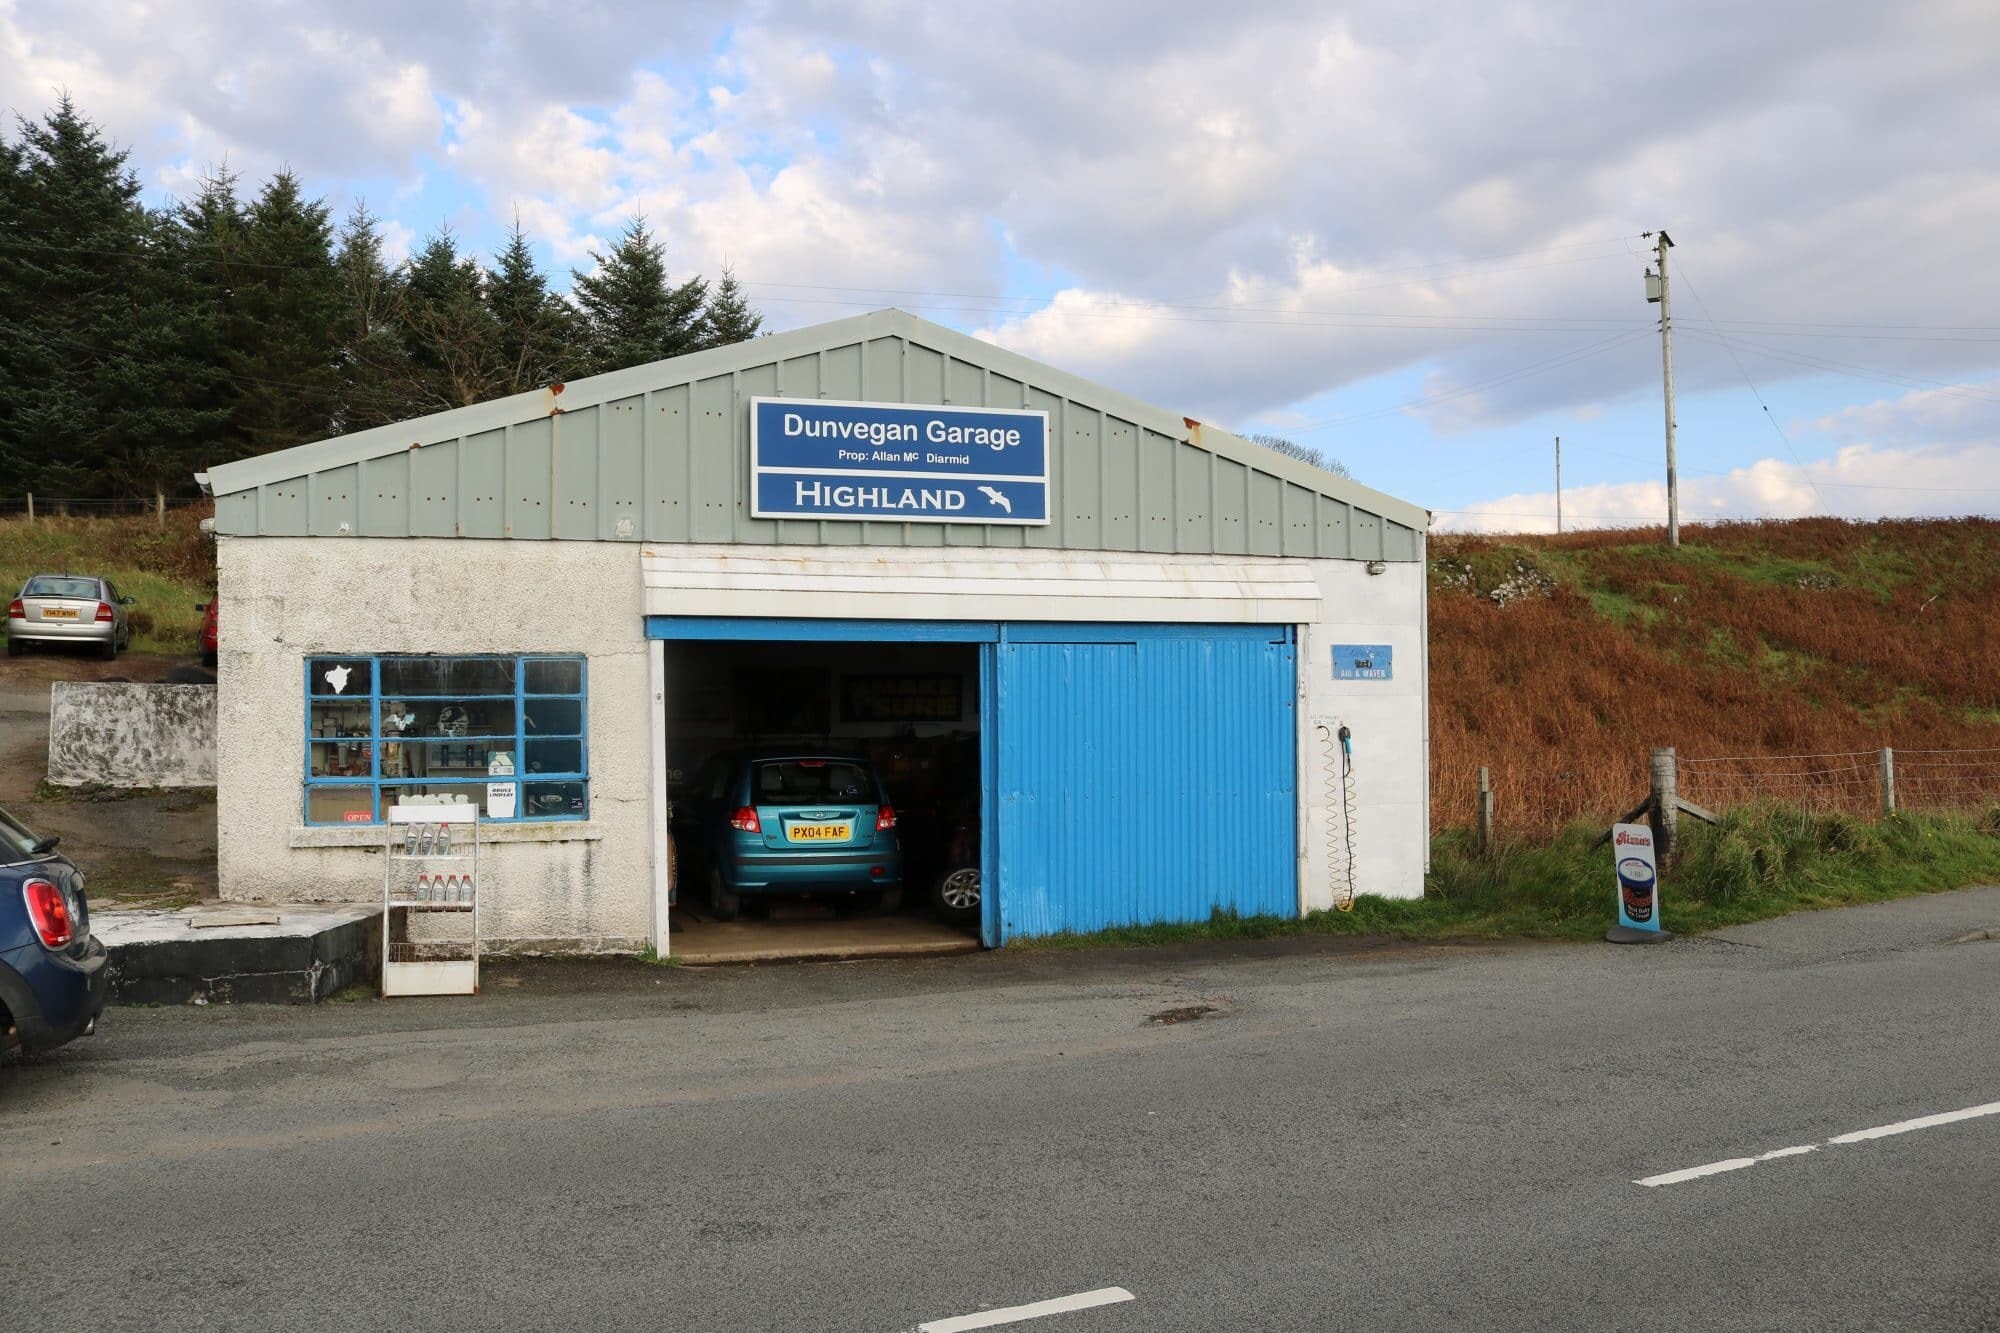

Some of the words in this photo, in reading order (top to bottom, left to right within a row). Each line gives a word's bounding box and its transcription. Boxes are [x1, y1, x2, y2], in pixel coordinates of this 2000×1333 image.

[784, 413, 918, 445] Dunvegan
[926, 420, 1020, 450] Garage
[838, 449, 869, 462] Prop:
[872, 451, 901, 462] Allan
[926, 453, 970, 464] Diarmid
[795, 481, 965, 510] HIGHLAND
[1363, 669, 1386, 678] WATER
[347, 814, 371, 822] OPEN
[793, 827, 821, 838] PX04
[824, 826, 845, 837] FAF
